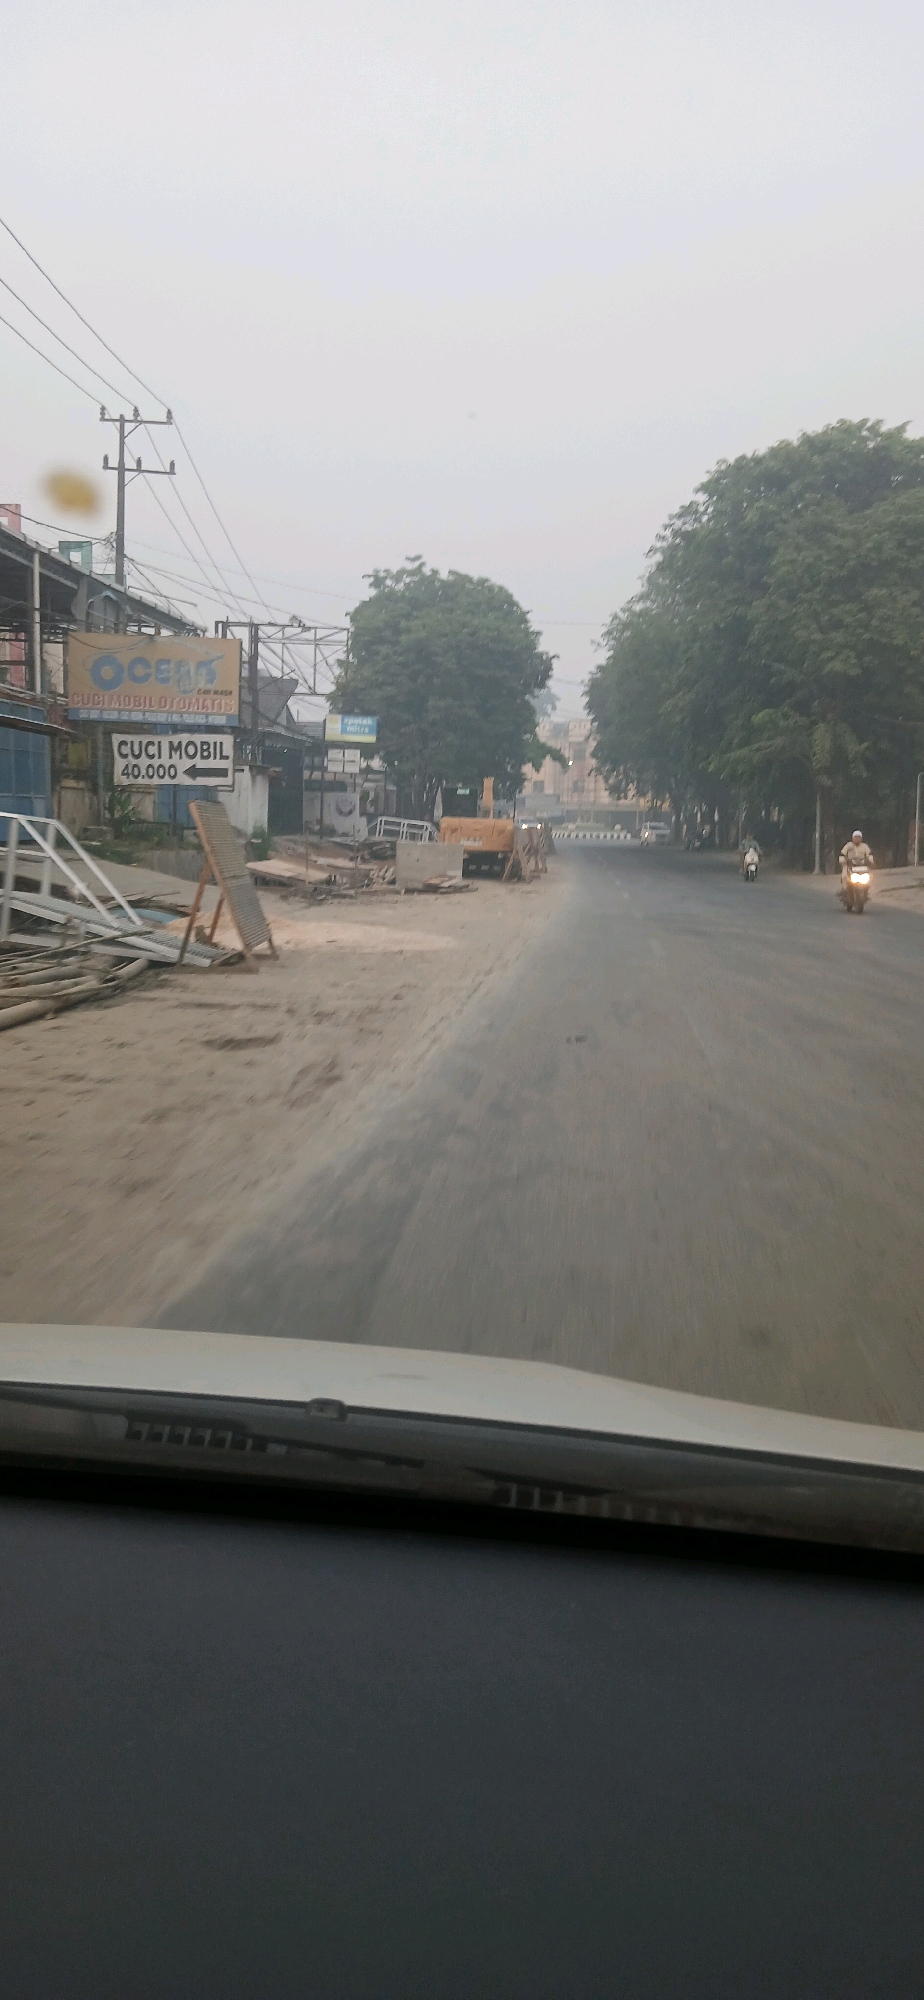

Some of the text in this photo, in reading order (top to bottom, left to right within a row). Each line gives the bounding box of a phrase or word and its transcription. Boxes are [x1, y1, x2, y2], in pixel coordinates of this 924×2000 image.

[71, 692, 235, 714] CUCI MOBIL OTOMATIS
[117, 740, 230, 760] CUCI MOBIL
[121, 763, 178, 780] 40.000
